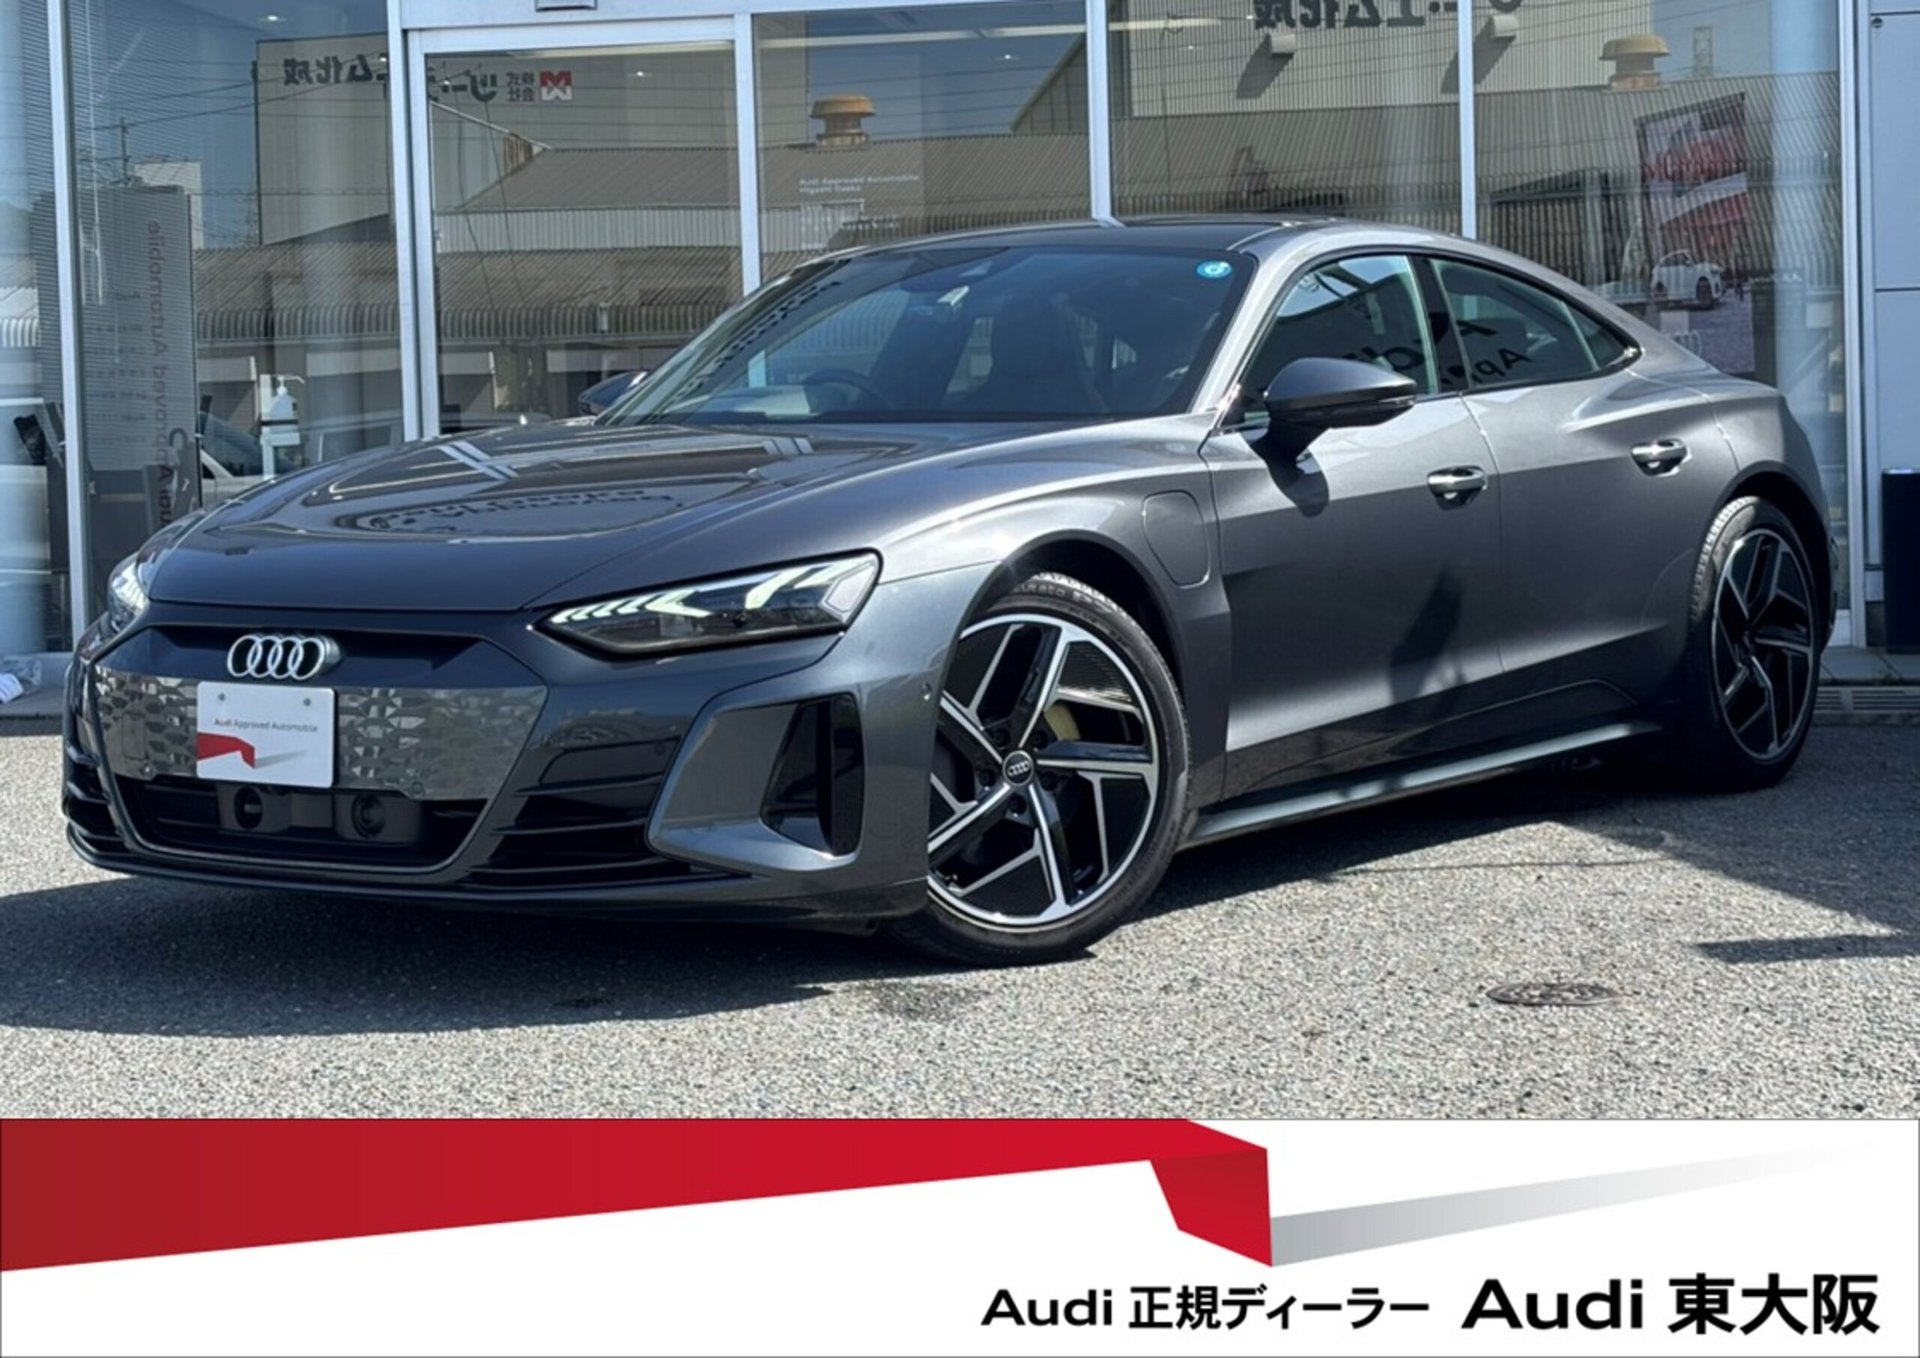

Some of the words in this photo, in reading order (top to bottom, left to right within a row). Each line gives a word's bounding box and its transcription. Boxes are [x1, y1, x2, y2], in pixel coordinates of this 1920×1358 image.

[214, 718, 232, 726] Audi
[234, 719, 270, 729] Approved
[271, 721, 317, 731] Automobile
